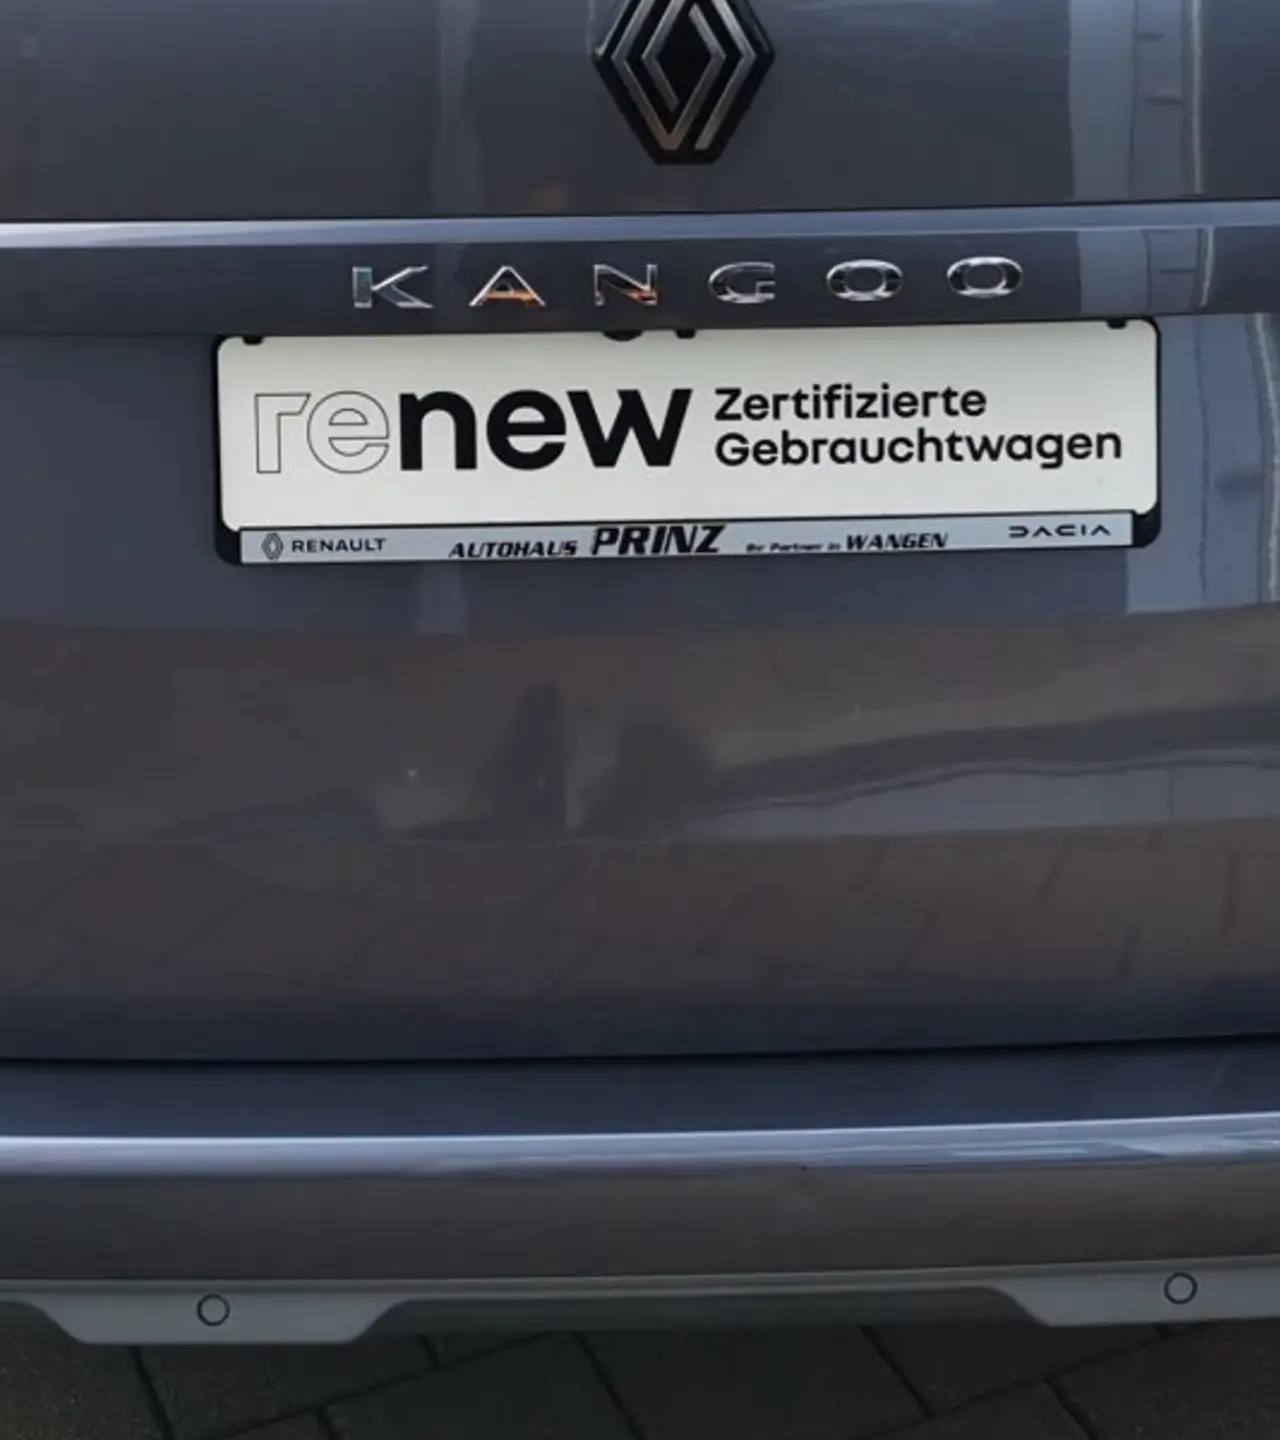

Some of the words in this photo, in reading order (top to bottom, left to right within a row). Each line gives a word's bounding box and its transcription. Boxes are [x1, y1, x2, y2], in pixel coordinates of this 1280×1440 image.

[351, 255, 1024, 311] KANGOO
[714, 382, 988, 422] Zertifizierte
[253, 387, 694, 476] renew
[714, 426, 1122, 471] Gebrauchtwagen
[291, 536, 387, 554] RENAULT
[448, 539, 578, 559] AUTOHAUS
[591, 524, 726, 556] PRINZ
[845, 532, 948, 550] WANGEN
[1007, 523, 1112, 539] DACIA
